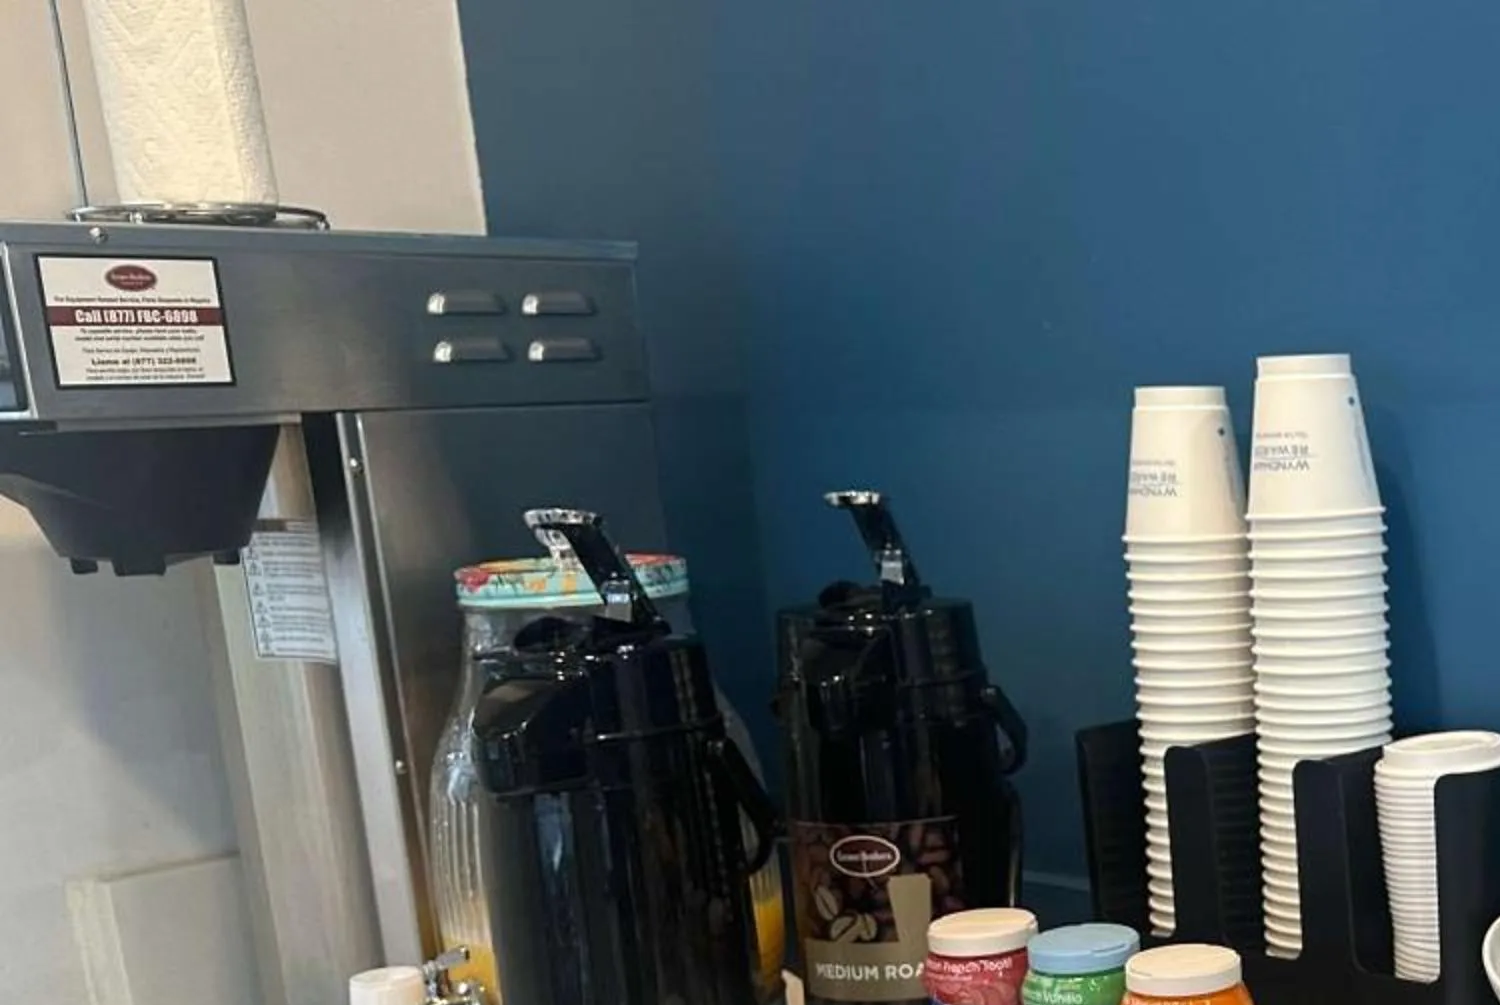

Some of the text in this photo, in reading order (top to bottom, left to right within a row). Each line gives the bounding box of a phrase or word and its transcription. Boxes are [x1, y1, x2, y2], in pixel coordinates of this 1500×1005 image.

[75, 310, 102, 323] Call
[815, 962, 879, 980] MEDIUM
[885, 963, 925, 980] ROA
